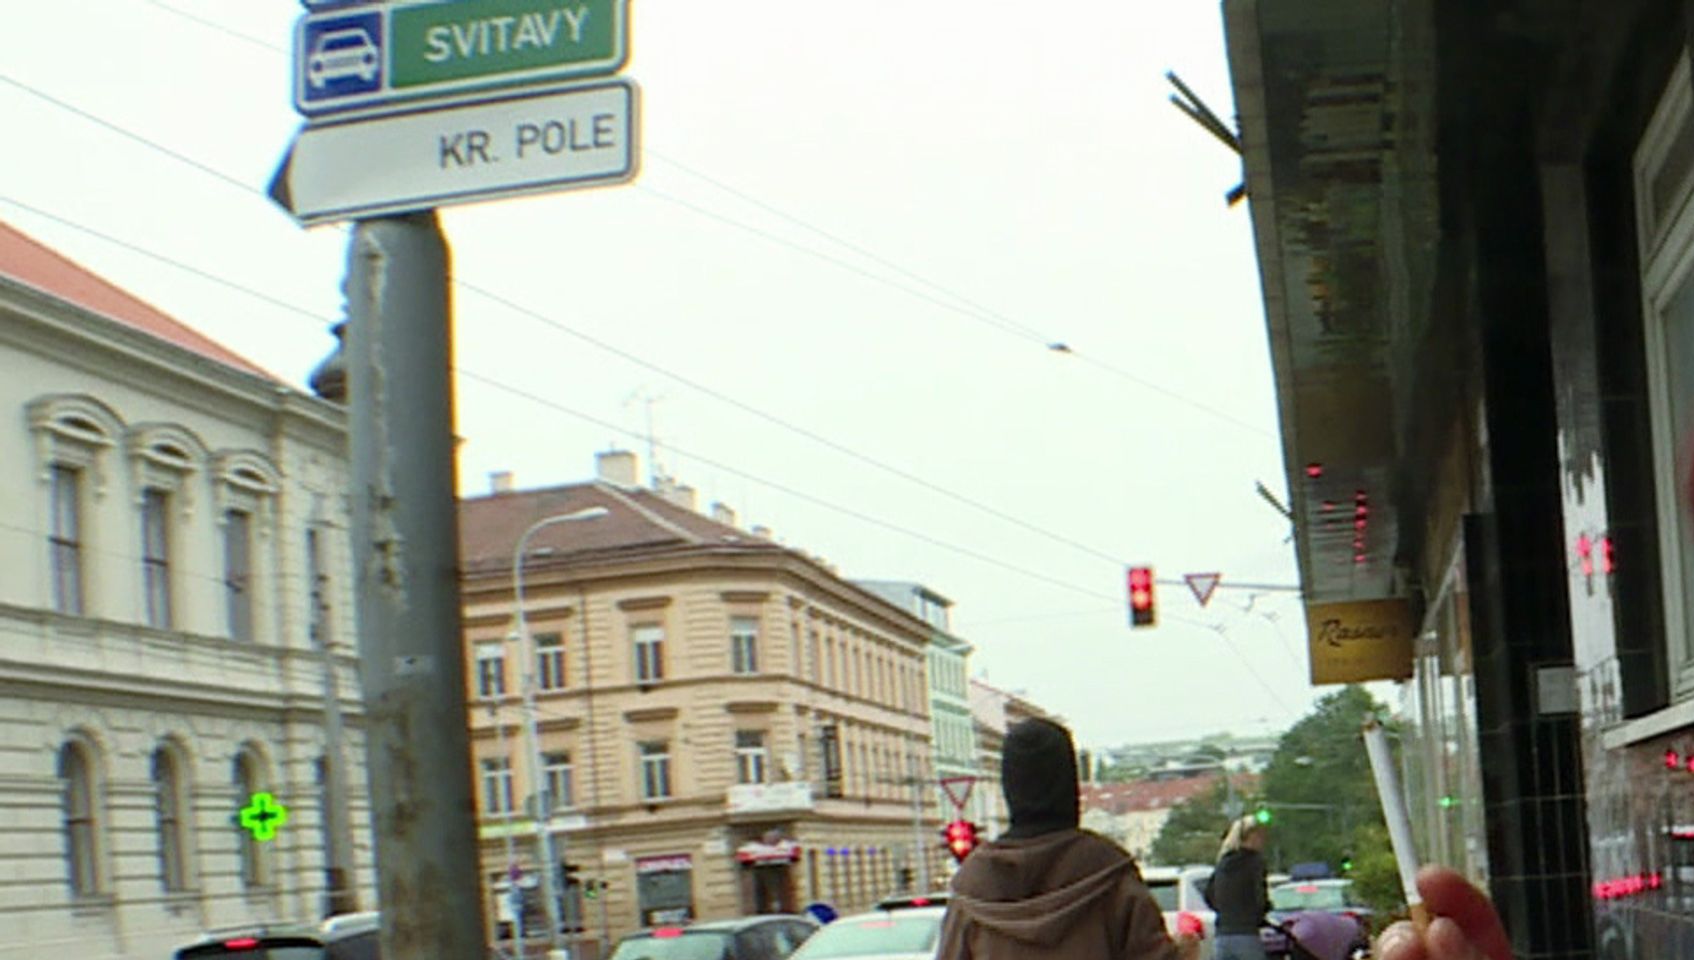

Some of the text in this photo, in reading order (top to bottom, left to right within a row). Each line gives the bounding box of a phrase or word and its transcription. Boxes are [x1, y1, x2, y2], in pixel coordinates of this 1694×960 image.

[423, 7, 589, 63] SVITAVY
[439, 113, 617, 169] KR. POLE
